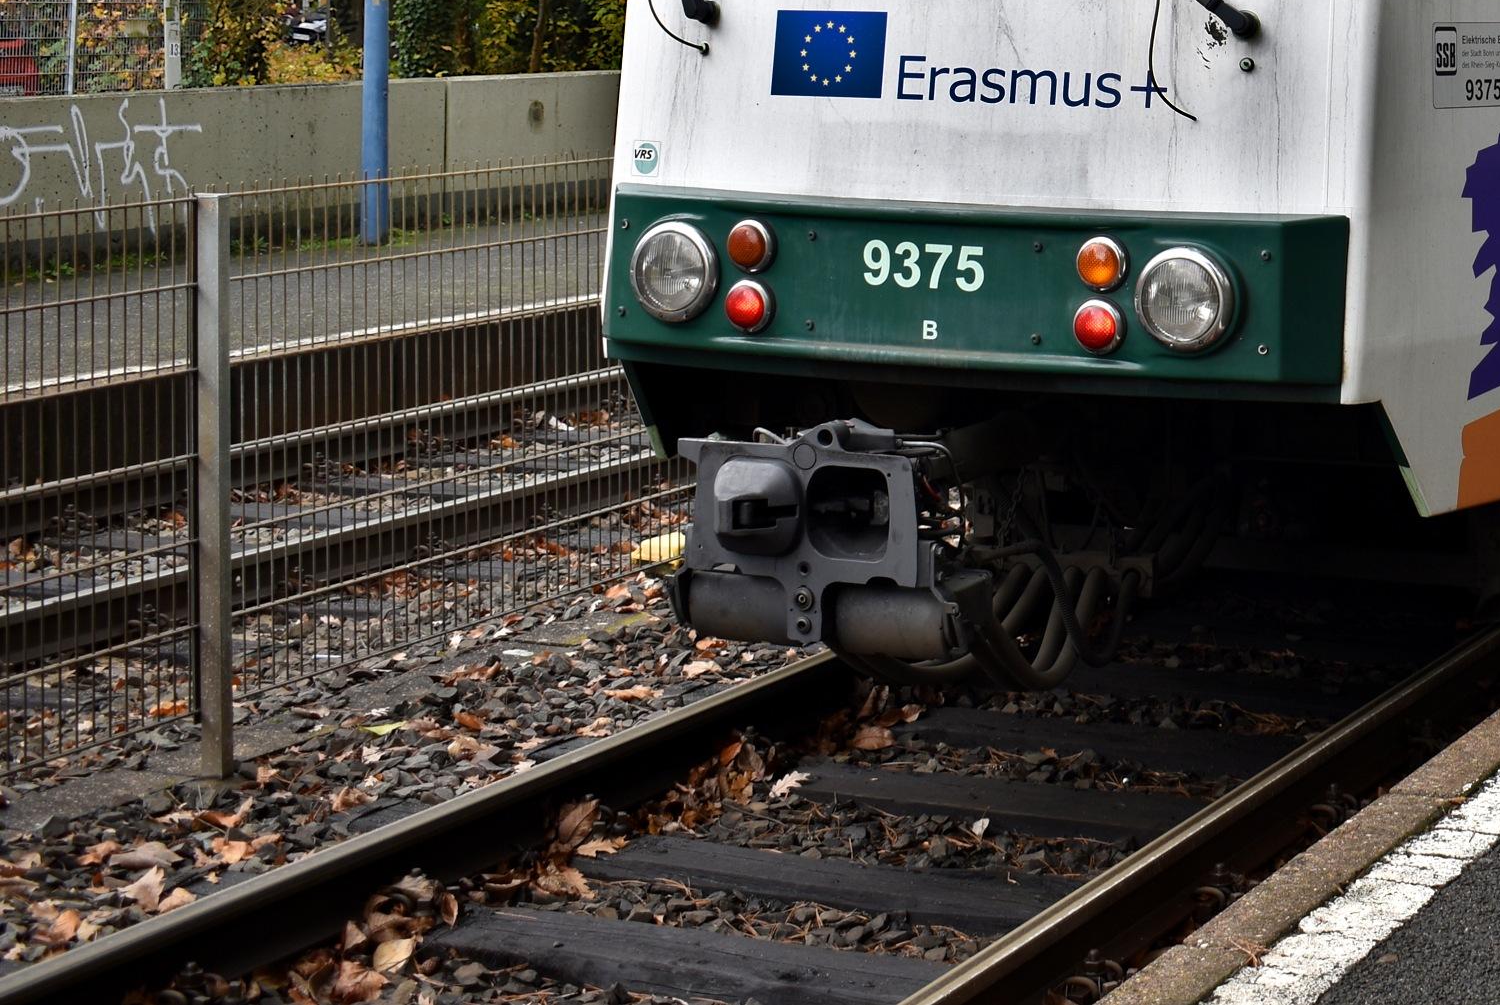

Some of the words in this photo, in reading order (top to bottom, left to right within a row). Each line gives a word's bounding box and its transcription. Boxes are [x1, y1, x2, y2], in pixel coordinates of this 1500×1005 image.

[1462, 35, 1496, 44] Elektrische
[1436, 42, 1456, 68] SSB
[896, 54, 1169, 109] Erasmus+
[634, 148, 653, 160] VRS
[861, 239, 987, 293] 9375
[921, 320, 939, 341] B
